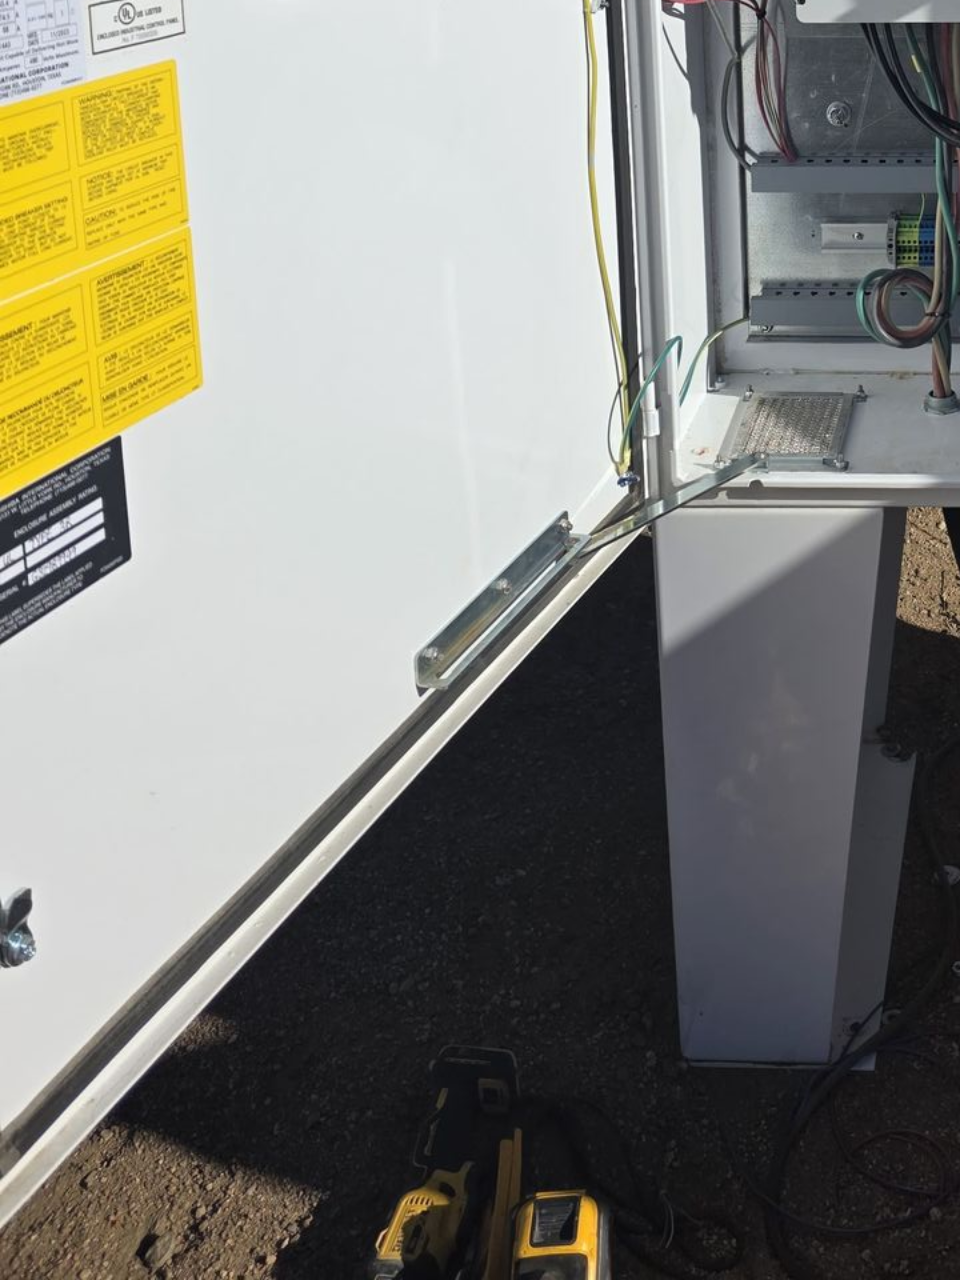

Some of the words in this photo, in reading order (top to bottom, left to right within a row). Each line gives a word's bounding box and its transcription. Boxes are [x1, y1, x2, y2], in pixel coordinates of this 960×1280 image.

[122, 7, 132, 20] UL
[28, 61, 69, 77] CORPORATION
[128, 373, 149, 390] GARDE
[69, 446, 112, 474] CORPORATION
[13, 513, 48, 539] ENCLOSURE
[48, 496, 77, 517] ASSEMBLY
